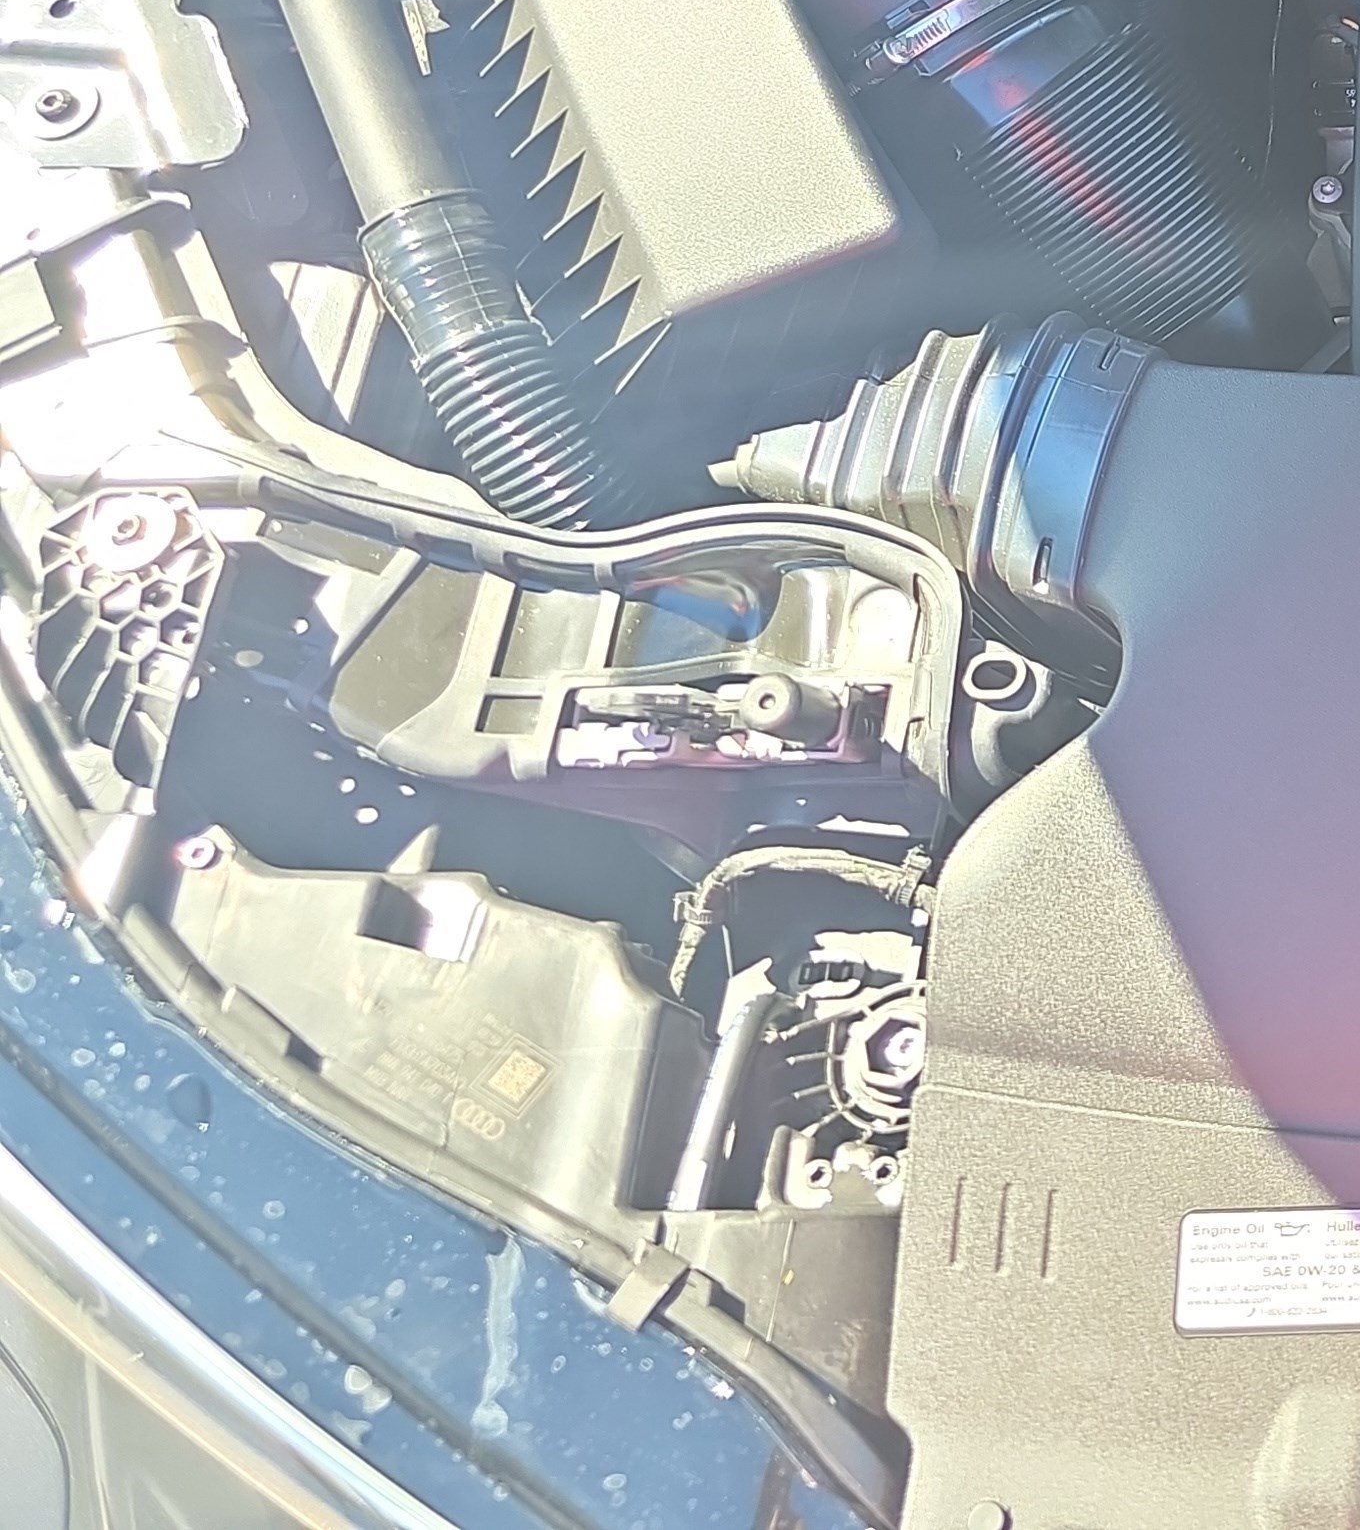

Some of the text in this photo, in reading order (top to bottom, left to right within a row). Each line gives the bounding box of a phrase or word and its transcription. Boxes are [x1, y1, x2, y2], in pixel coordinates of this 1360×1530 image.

[1192, 1223, 1265, 1238] Engine Oil
[1262, 1265, 1293, 1277] SAE
[1297, 1264, 1346, 1276] 0W-20
